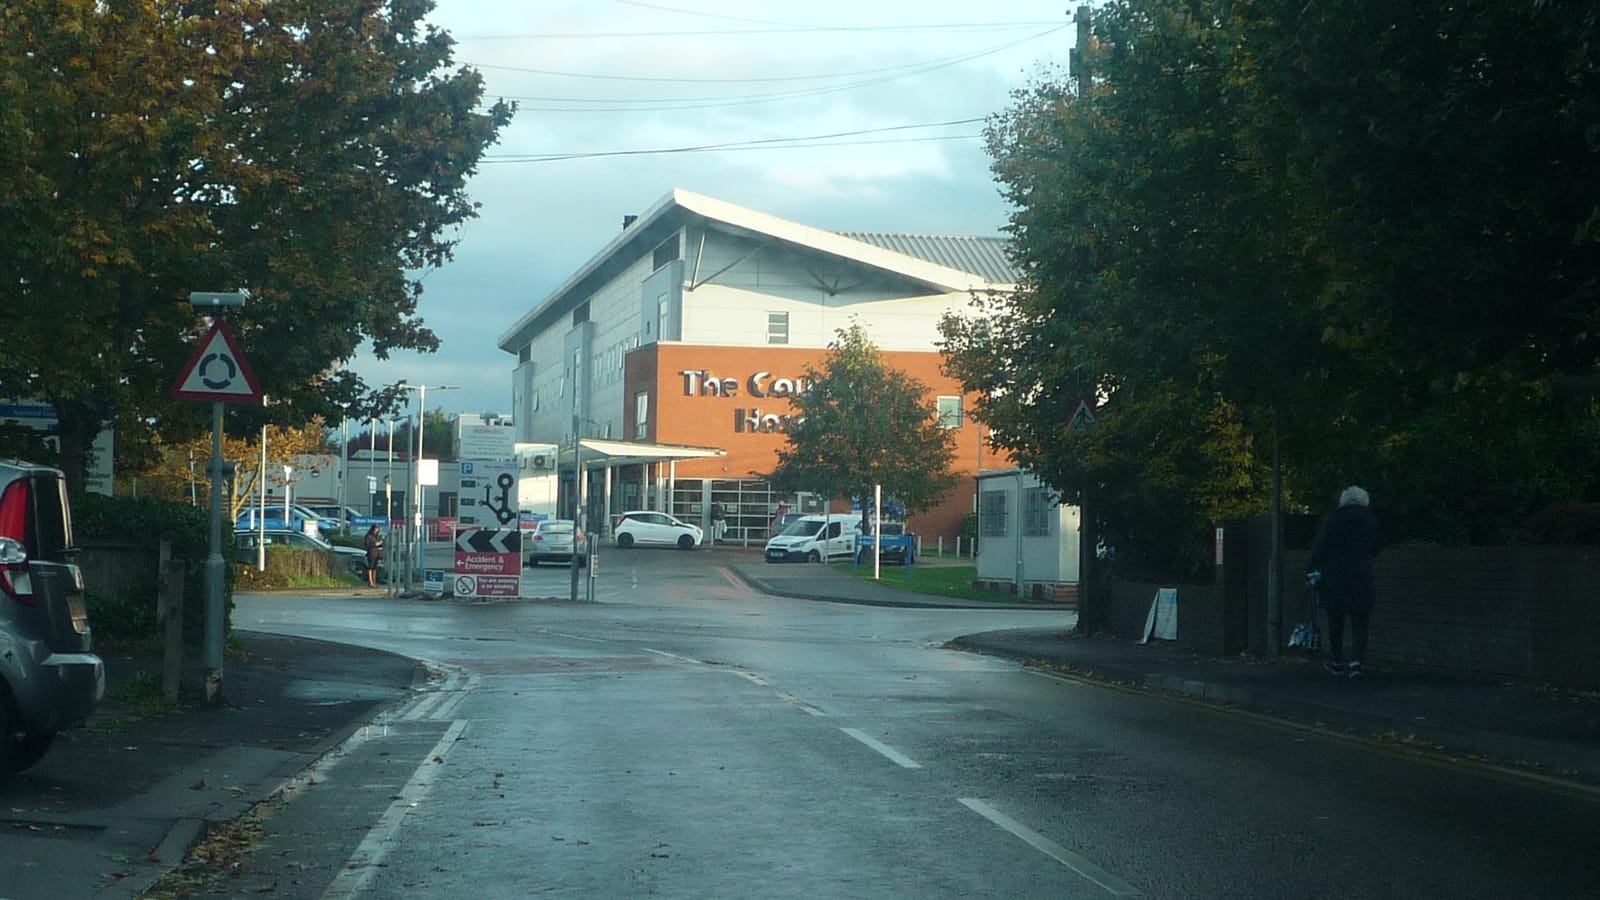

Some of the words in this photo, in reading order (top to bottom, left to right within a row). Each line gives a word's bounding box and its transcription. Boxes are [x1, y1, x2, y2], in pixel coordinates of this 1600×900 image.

[678, 370, 738, 397] The
[463, 464, 472, 474] P
[465, 563, 504, 572] Emergency
